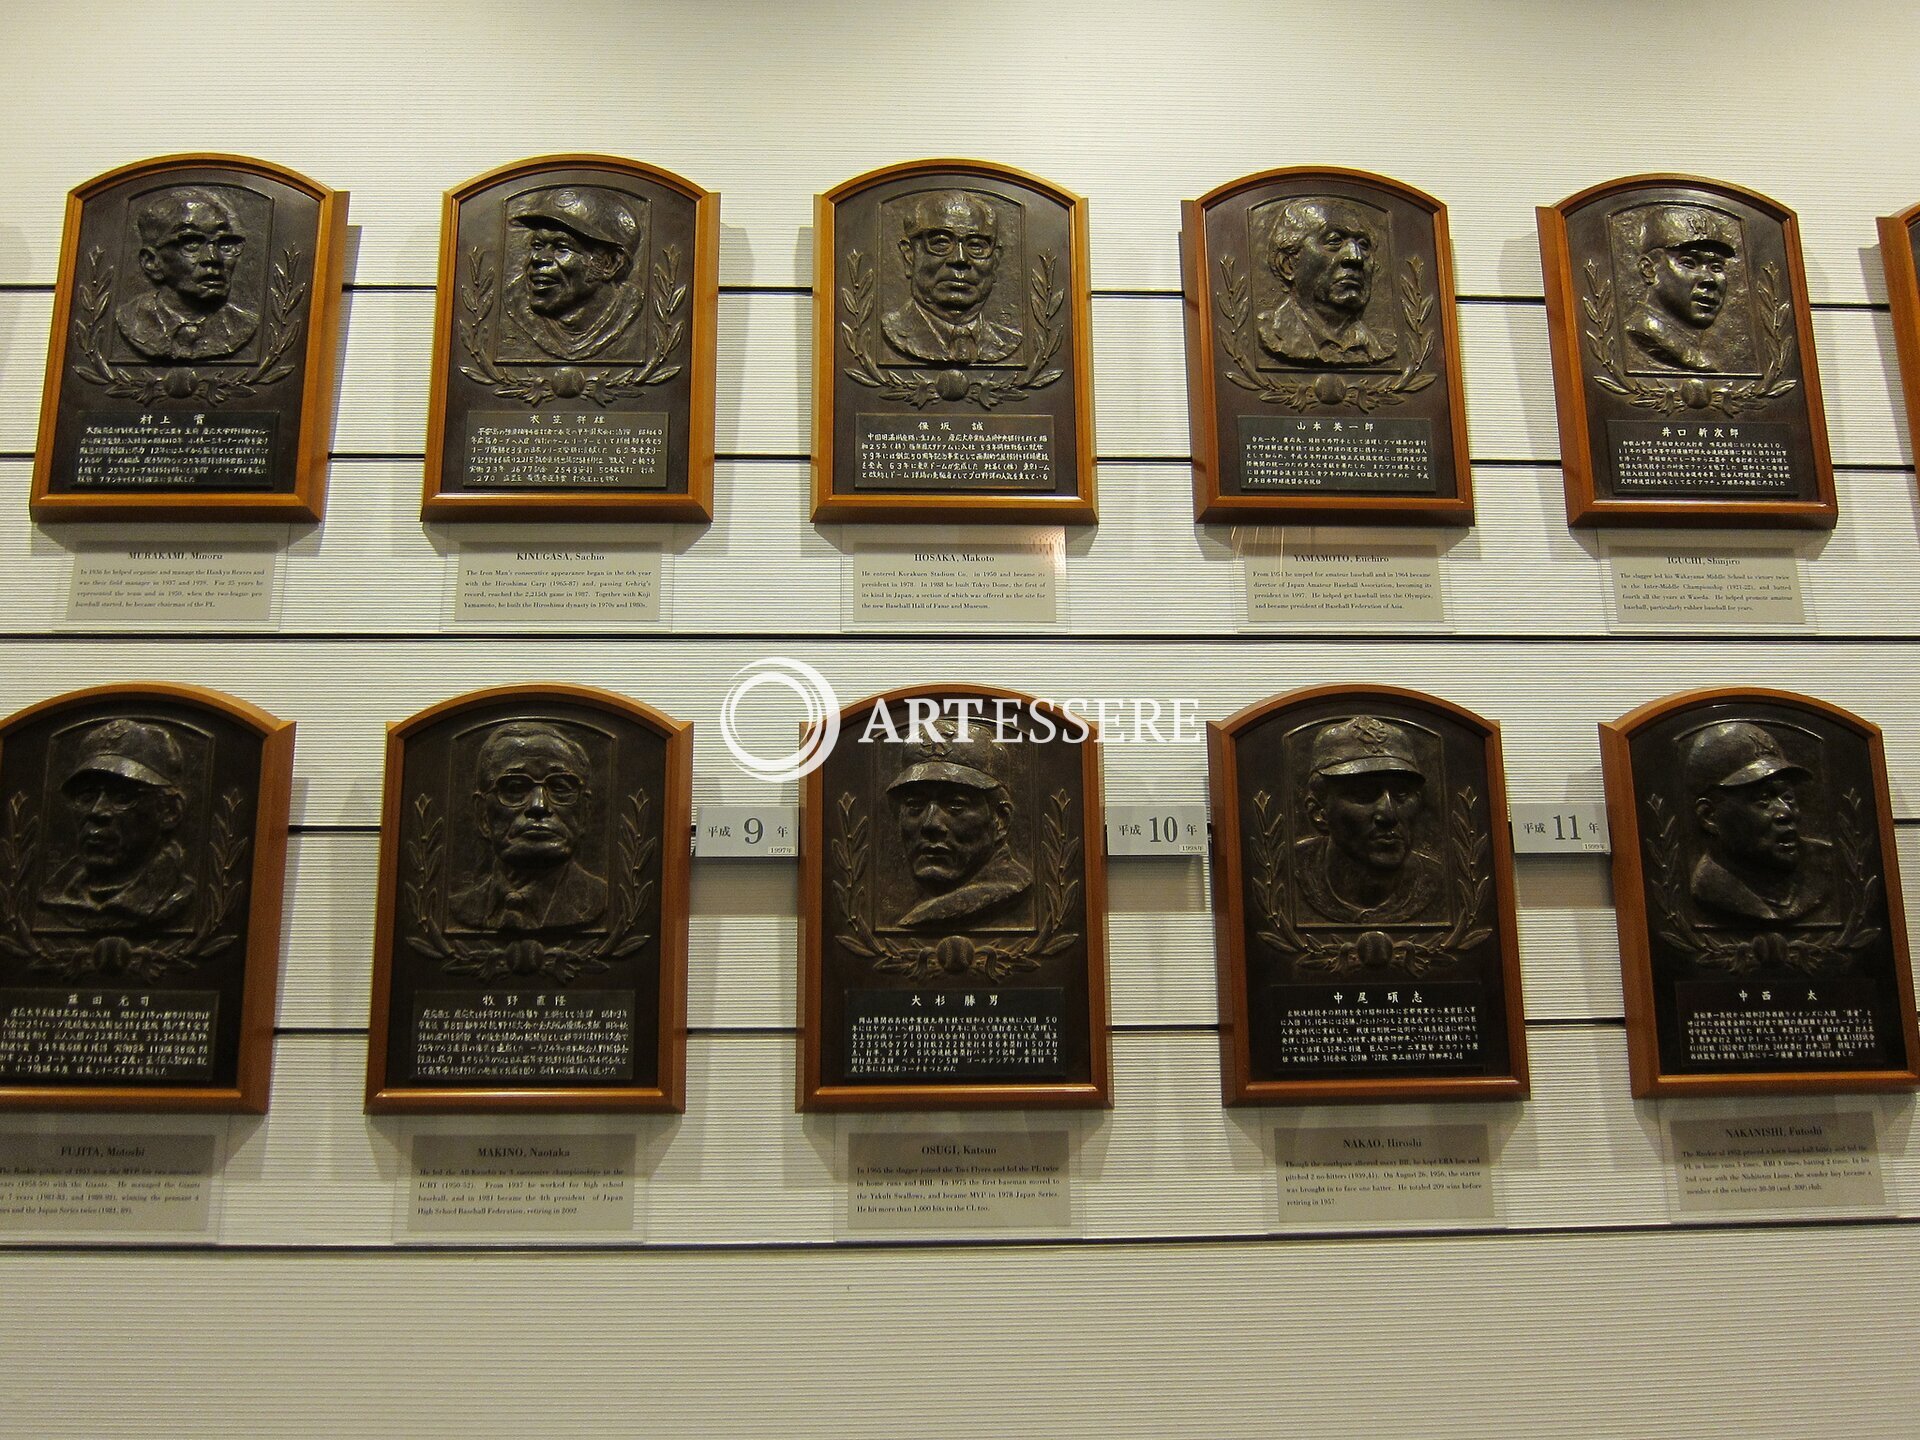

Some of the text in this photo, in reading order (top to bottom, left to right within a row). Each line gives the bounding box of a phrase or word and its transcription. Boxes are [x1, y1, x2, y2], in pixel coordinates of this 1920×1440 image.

[129, 551, 222, 561] MURAKAMI, Minoru
[516, 552, 604, 562] KINUGASA, Sachio
[914, 554, 994, 563] HOSAKA, Makoto
[1294, 554, 1389, 564] YAMAMOTO, Eiichiro
[1667, 557, 1740, 568] IGUCHI, Shinjiro
[708, 818, 789, 844] 平成 9 年
[1119, 816, 1198, 843] 平成 10 年
[1524, 815, 1599, 840] 平成 11 年
[1342, 1139, 1421, 1149] NAKAO, Hiroshi
[478, 1148, 526, 1158] MAKINO,
[921, 1146, 996, 1155] OSUGI, Katsuo
